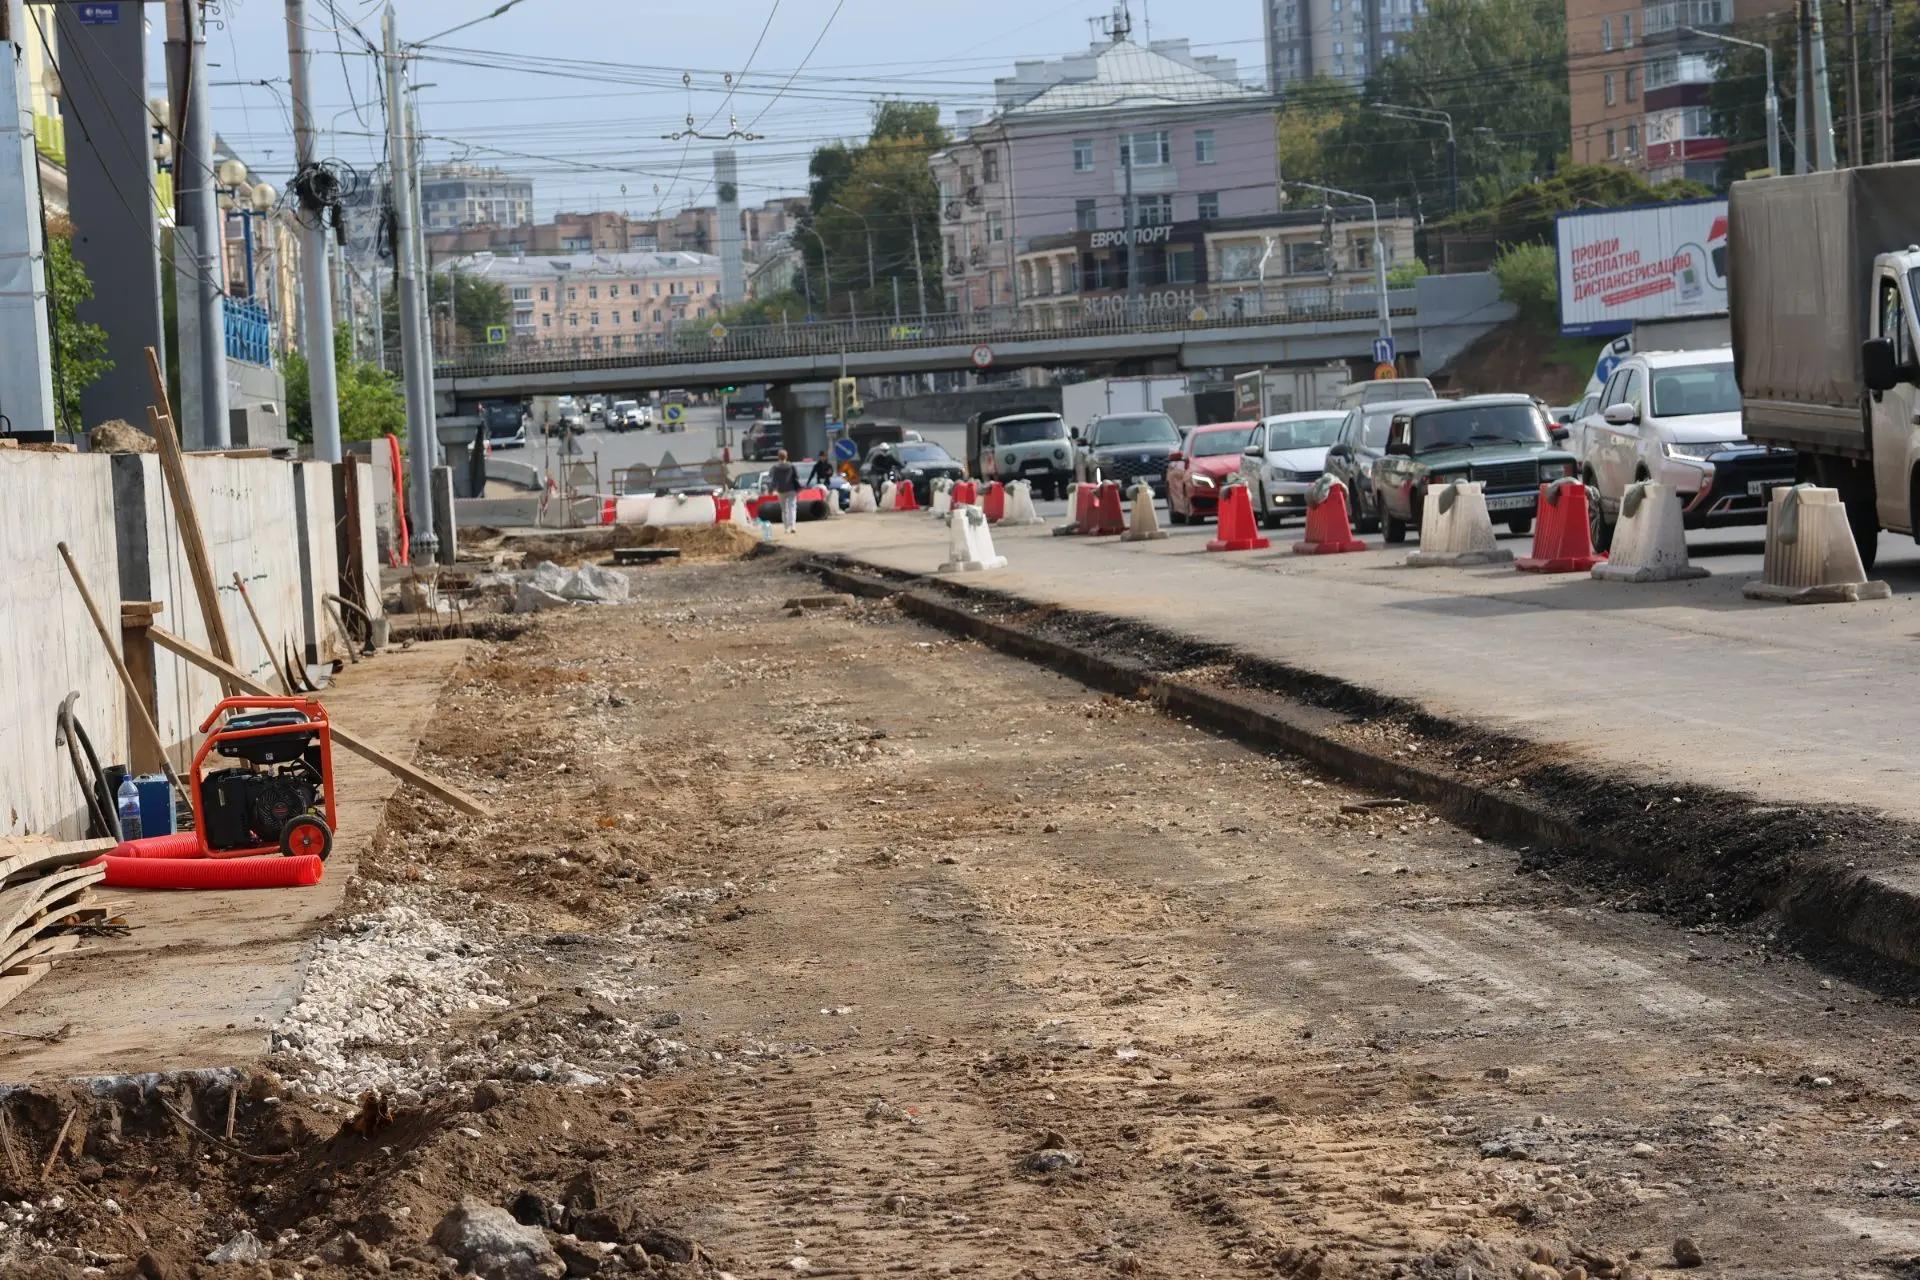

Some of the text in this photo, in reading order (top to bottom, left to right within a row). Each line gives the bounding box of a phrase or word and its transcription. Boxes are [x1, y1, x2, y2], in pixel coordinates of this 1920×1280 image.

[1090, 225, 1174, 249] ЕВРОСПОРТ
[1571, 237, 1620, 265] ПРОЙДИ
[1572, 249, 1640, 283] БЕСПЛАТНО
[1573, 252, 1692, 302] ДИСПАНСЕРИЗАЦИЮ
